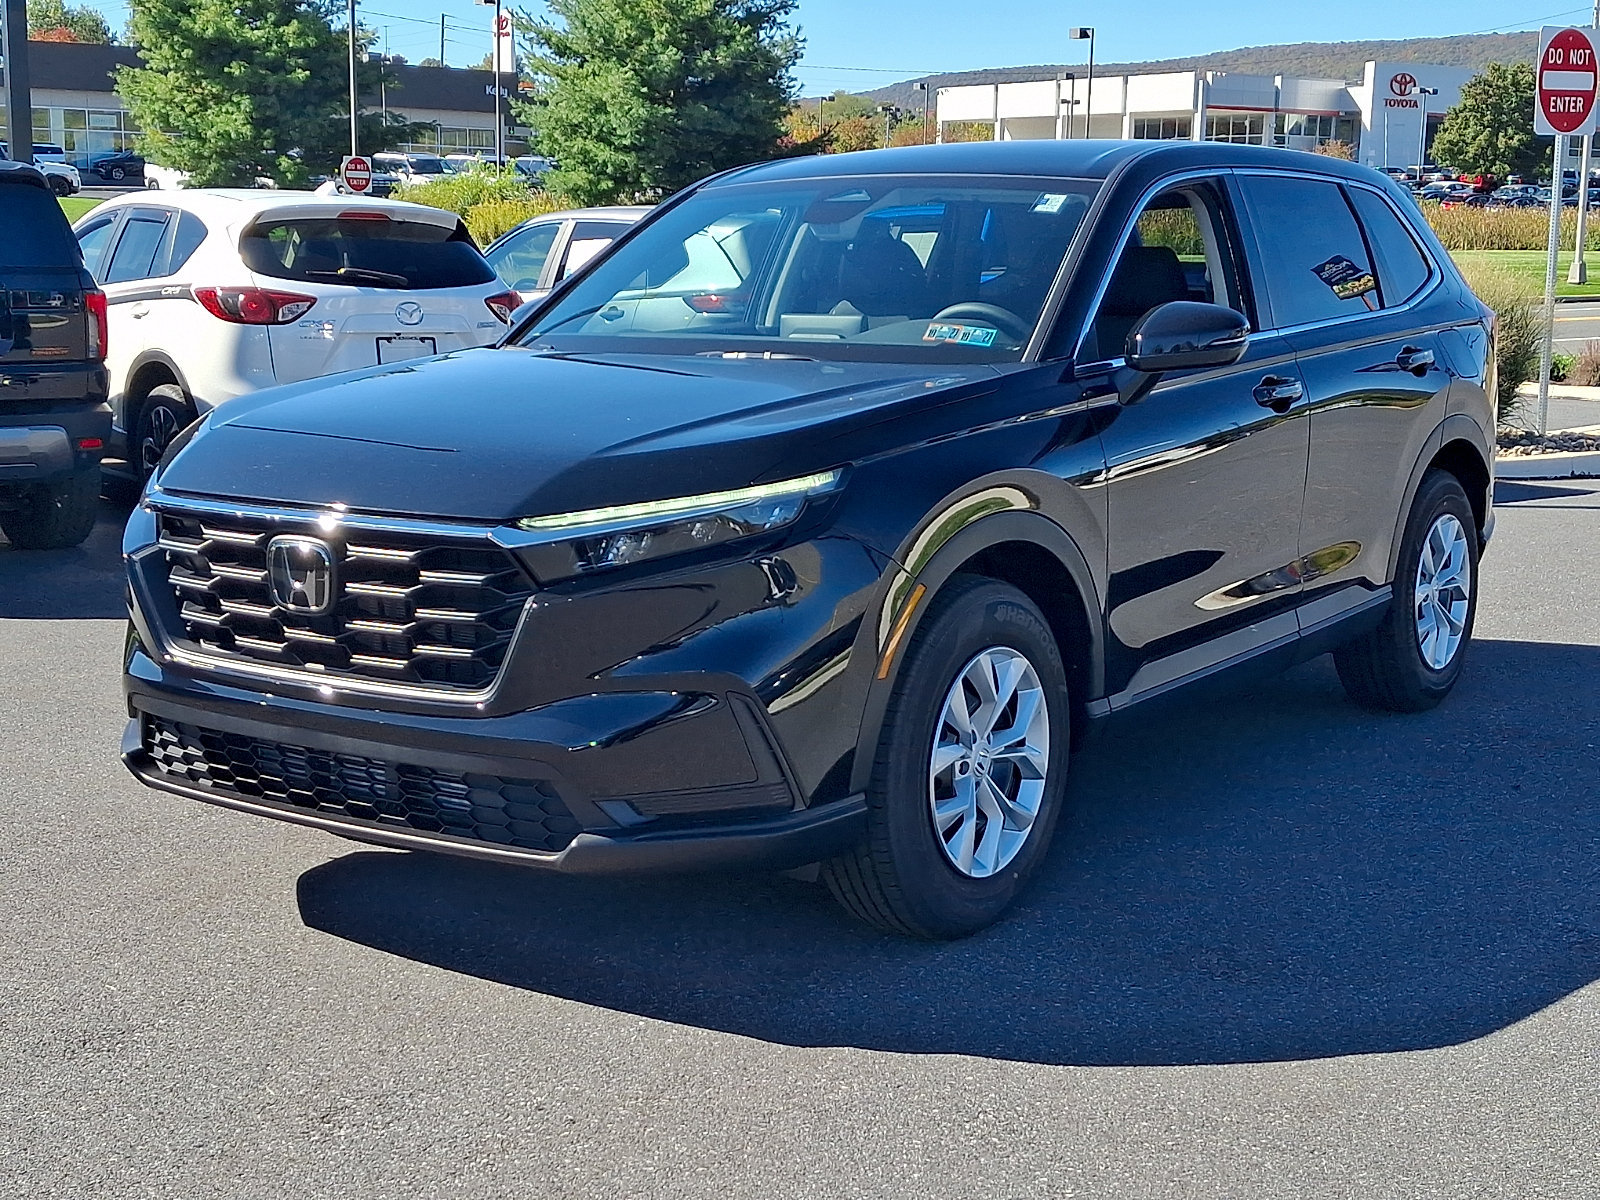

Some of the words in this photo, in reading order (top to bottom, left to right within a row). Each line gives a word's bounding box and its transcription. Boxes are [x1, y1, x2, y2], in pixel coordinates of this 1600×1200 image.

[1548, 48, 1564, 65] DO
[1569, 49, 1592, 66] NOT
[485, 84, 508, 97] Kely
[1384, 98, 1419, 108] TOYOTA
[1549, 96, 1584, 113] ENTER
[350, 178, 367, 186] ENTER
